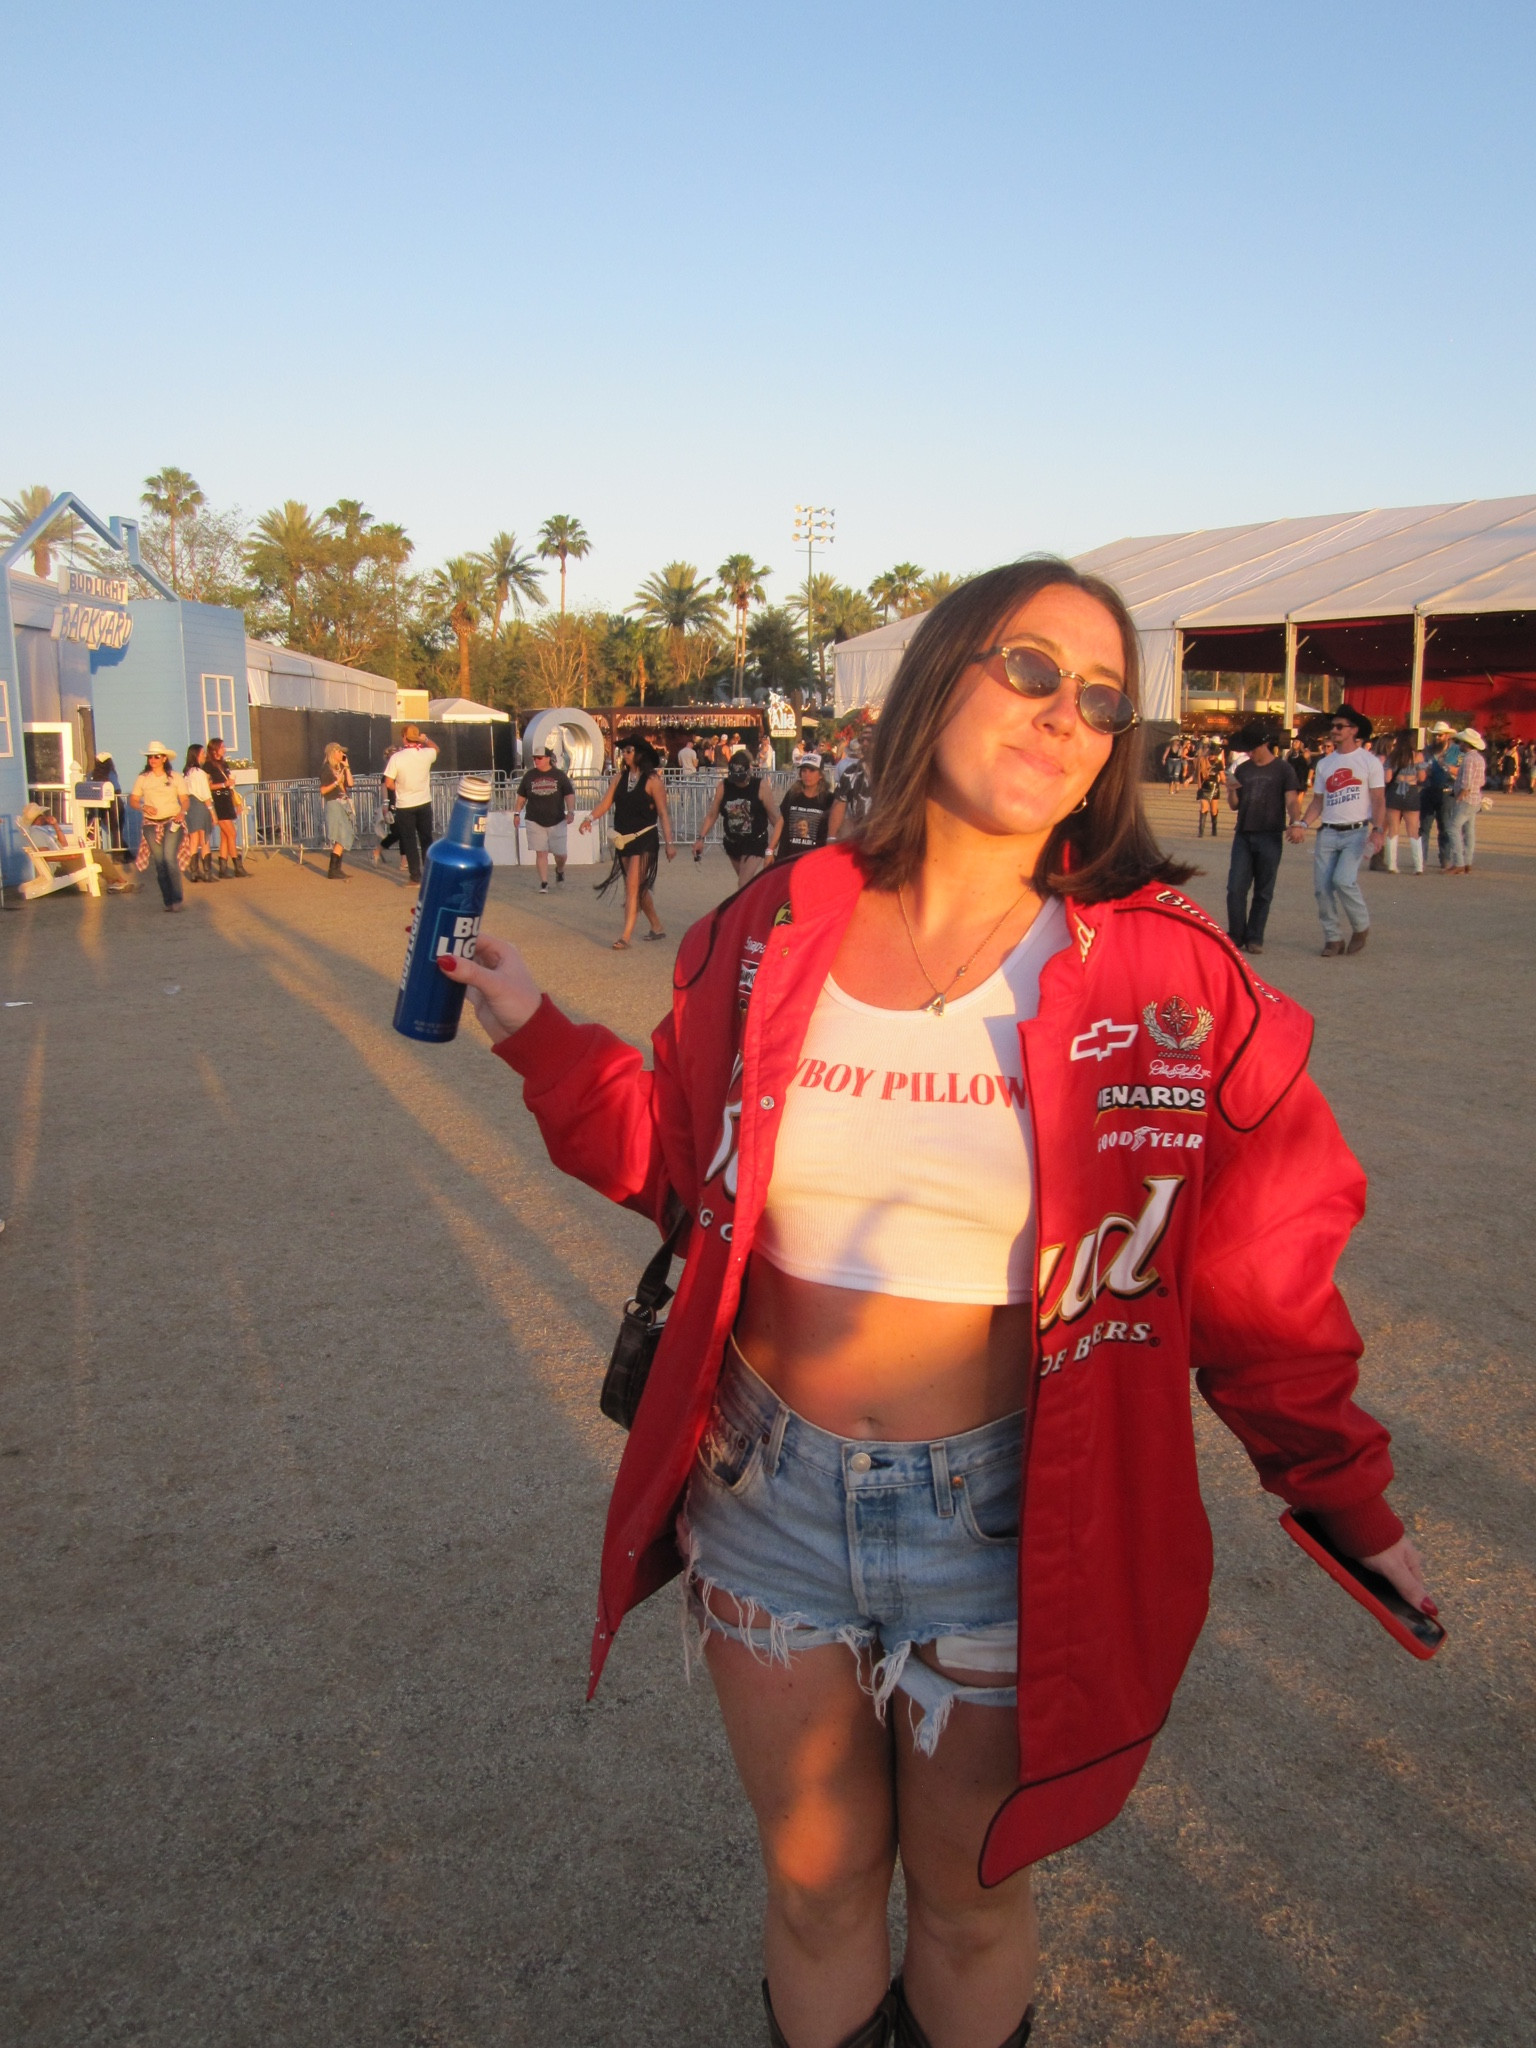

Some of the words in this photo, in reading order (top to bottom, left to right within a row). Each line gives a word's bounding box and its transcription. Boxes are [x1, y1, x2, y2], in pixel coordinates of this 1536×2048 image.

[69, 573, 94, 595] BUD
[95, 579, 126, 602] LIGHT
[60, 604, 133, 649] BACKYARD
[453, 916, 480, 938] BU
[436, 936, 477, 959] LIG
[797, 1058, 875, 1098] BOY
[1040, 1174, 1186, 1331] ud
